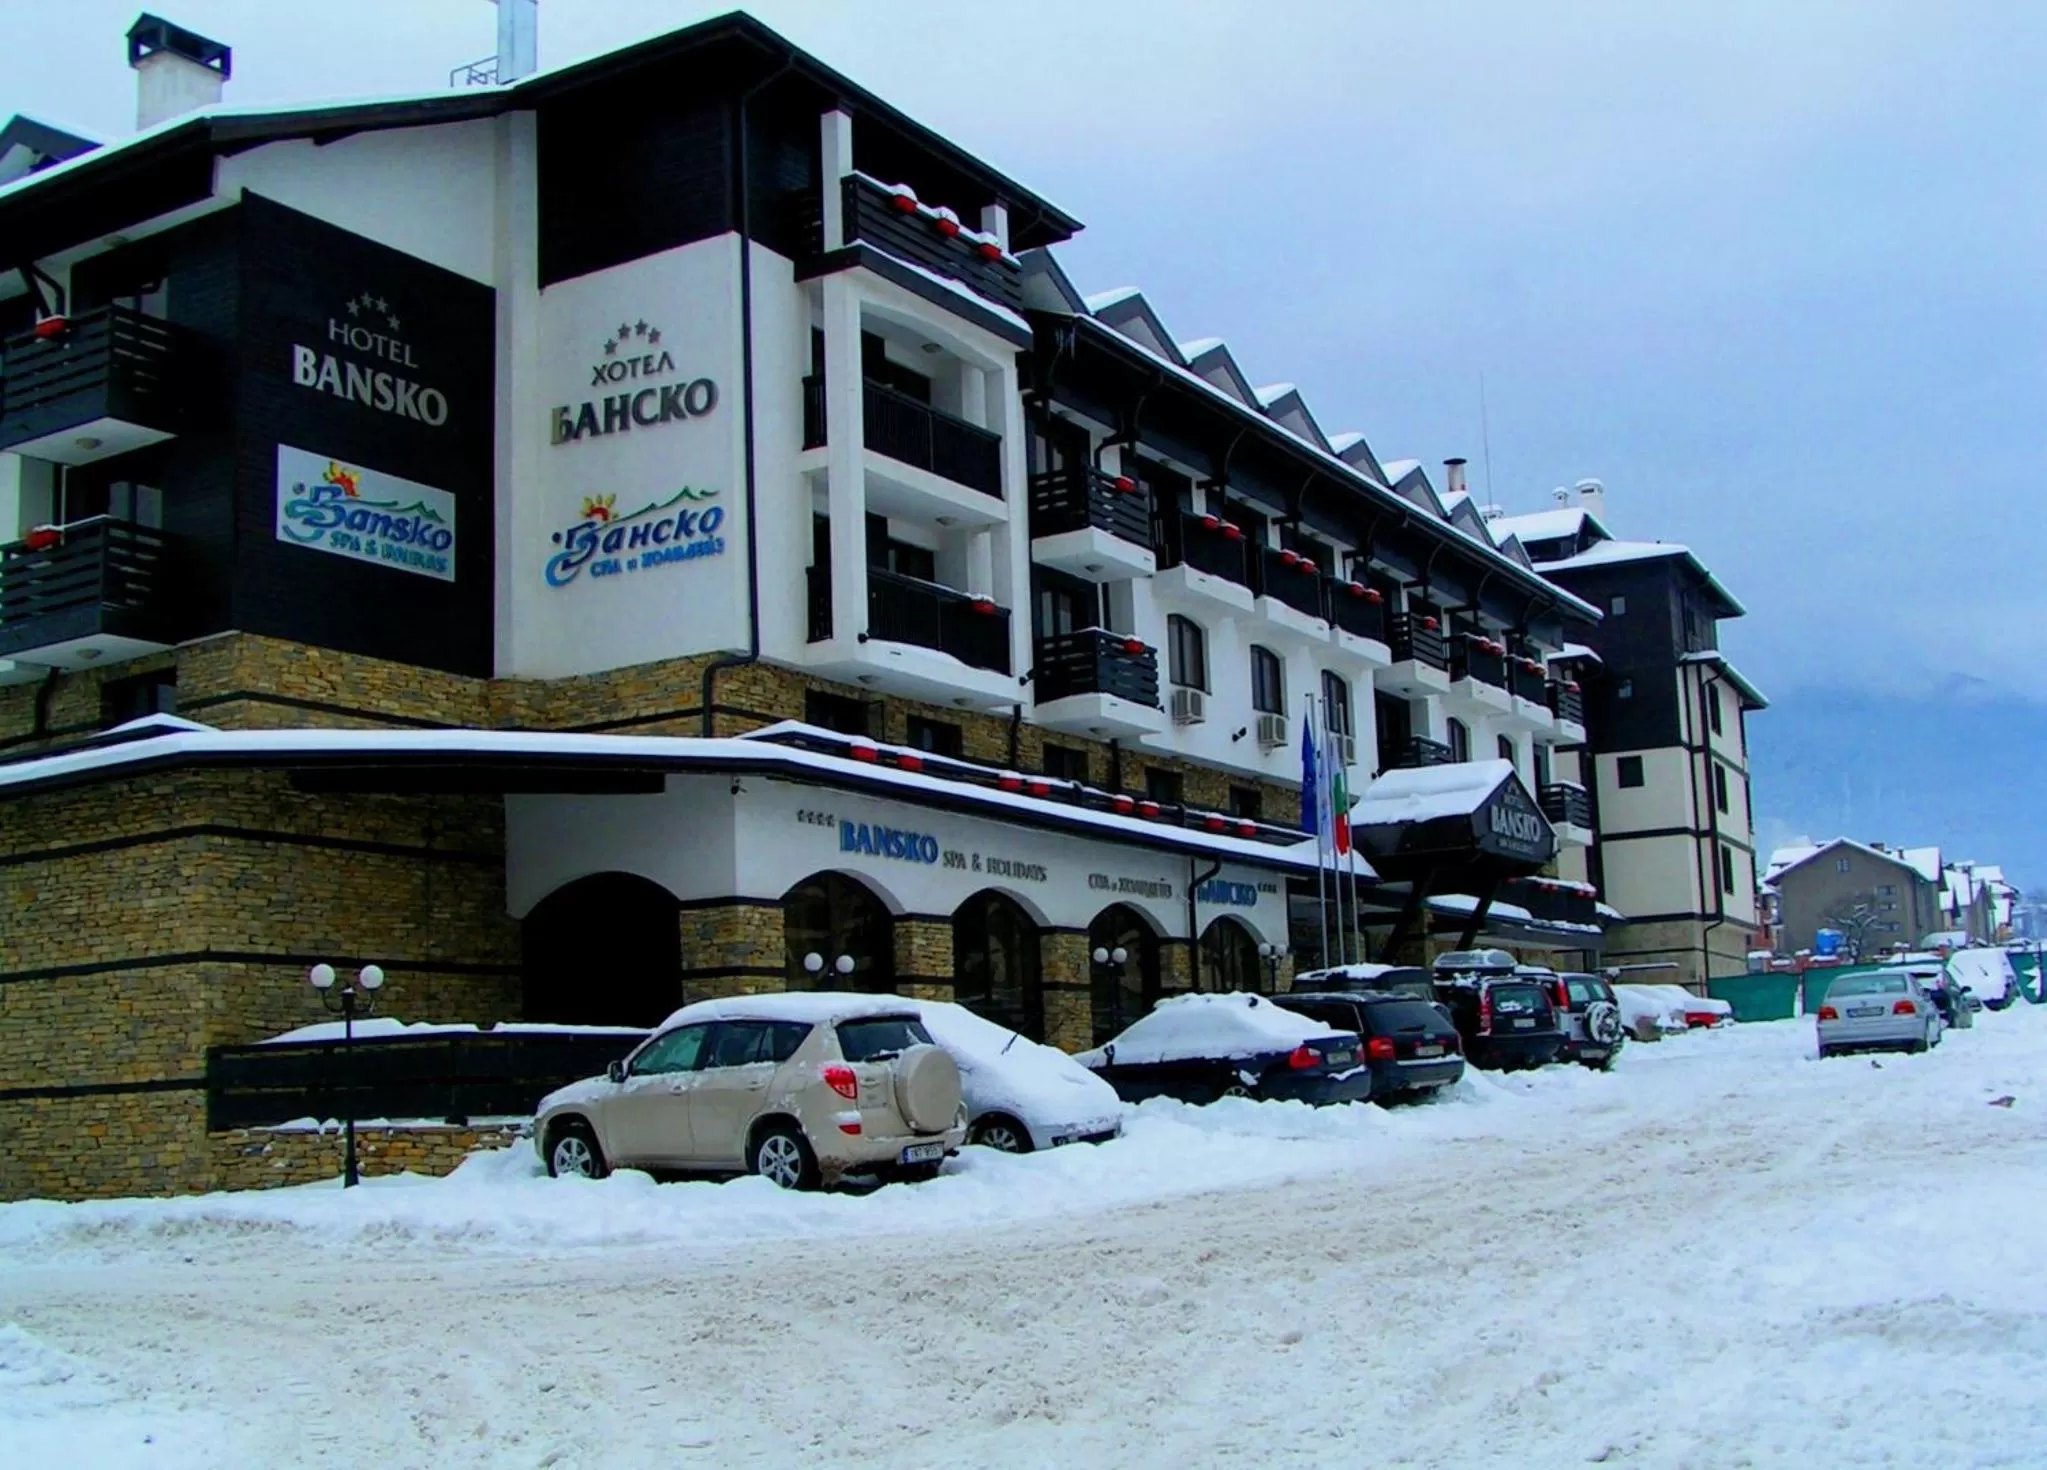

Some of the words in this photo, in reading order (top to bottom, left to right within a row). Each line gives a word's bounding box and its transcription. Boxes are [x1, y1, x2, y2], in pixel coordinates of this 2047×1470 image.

[328, 318, 419, 368] HOTEL
[591, 351, 675, 387] ХОТЕЛ
[293, 343, 448, 426] BANSKO
[551, 378, 719, 445] БАНСКО
[285, 485, 453, 552] Bansko
[553, 506, 724, 577] Банско
[839, 819, 939, 865] BANSKO
[942, 850, 967, 870] SPA
[971, 852, 982, 872] &
[986, 857, 1048, 882] HOLIDAYS
[1491, 804, 1540, 843] BANSKO
